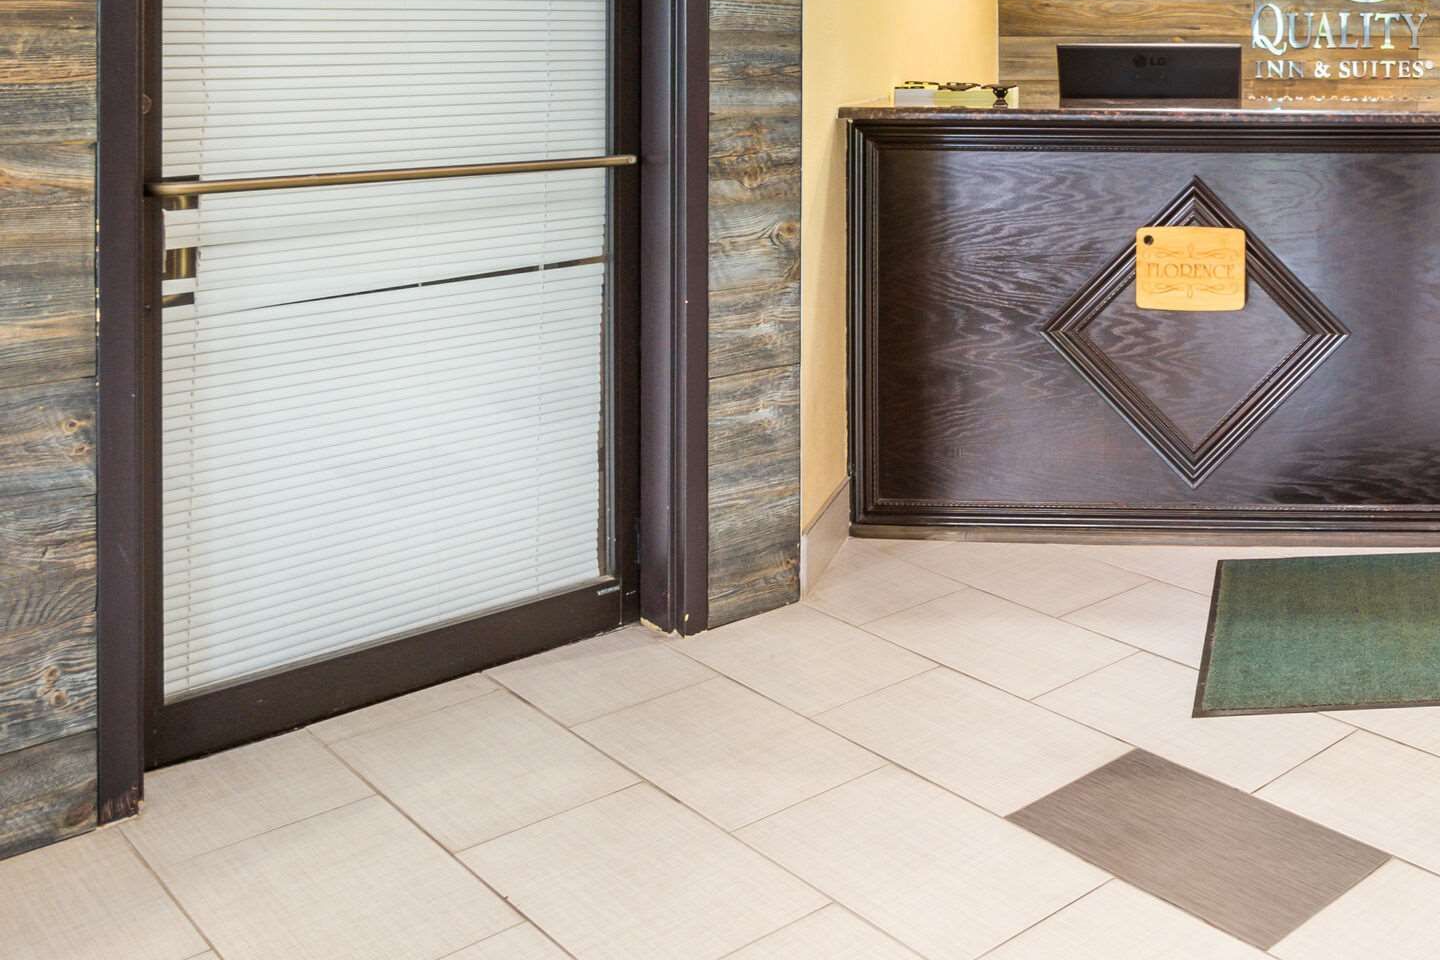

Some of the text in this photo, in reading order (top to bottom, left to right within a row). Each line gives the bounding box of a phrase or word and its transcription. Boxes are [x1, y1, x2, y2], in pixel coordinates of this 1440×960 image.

[1252, 3, 1427, 56] QUALITY
[1255, 60, 1304, 79] INN
[1314, 60, 1332, 79] &
[1146, 263, 1236, 279] FLORENCE
